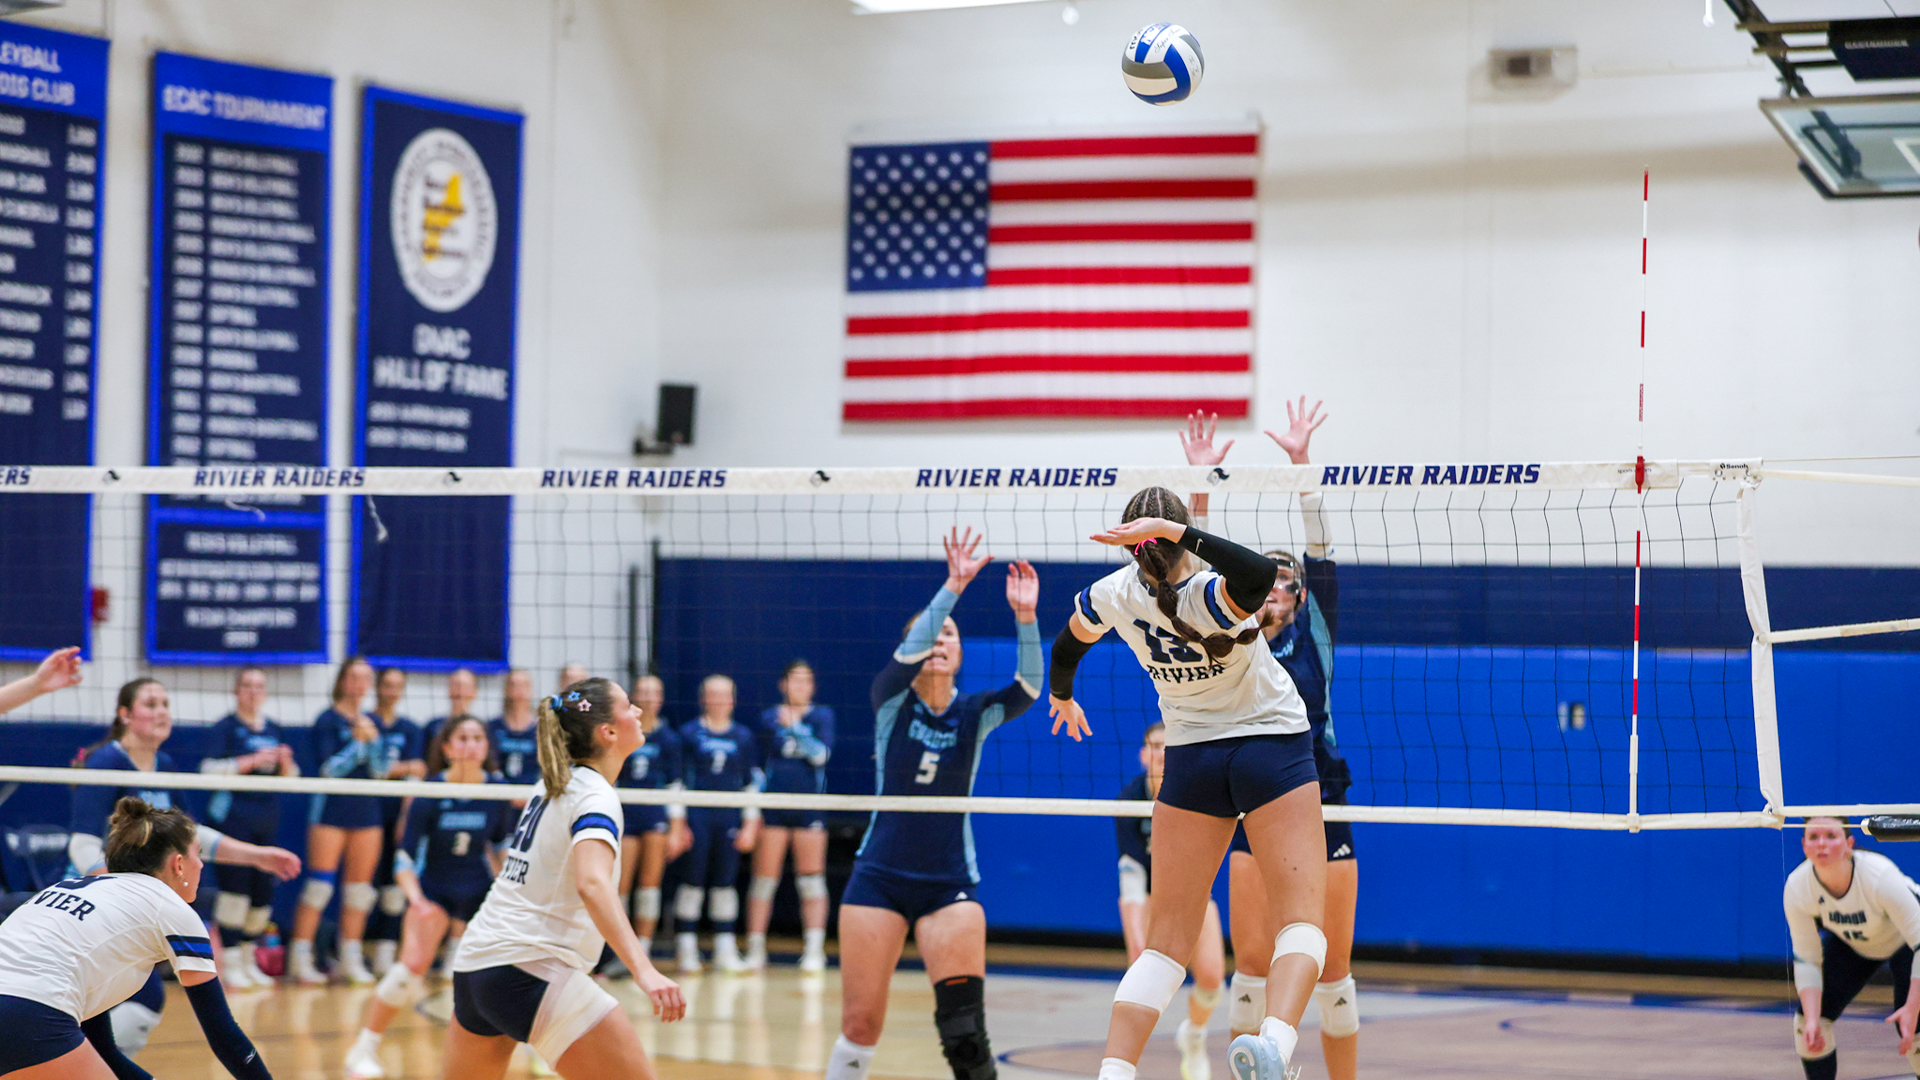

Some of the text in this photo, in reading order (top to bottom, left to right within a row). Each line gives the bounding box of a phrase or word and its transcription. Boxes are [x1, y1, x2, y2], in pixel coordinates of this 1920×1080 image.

[31, 77, 75, 106] CLUB
[212, 91, 327, 131] TOURNAMENT
[193, 469, 366, 487] RIVIER RAIDERS
[541, 470, 726, 488] RIVIER RAIDERS
[915, 468, 1118, 488] RIVIER RAIDERS
[1321, 464, 1541, 486] RIVIER RAIDERS
[1132, 618, 1204, 664] 13
[1146, 664, 1226, 684] RIVIER
[914, 750, 941, 785] 5
[502, 856, 530, 885] VIER
[33, 890, 96, 921] VIER
